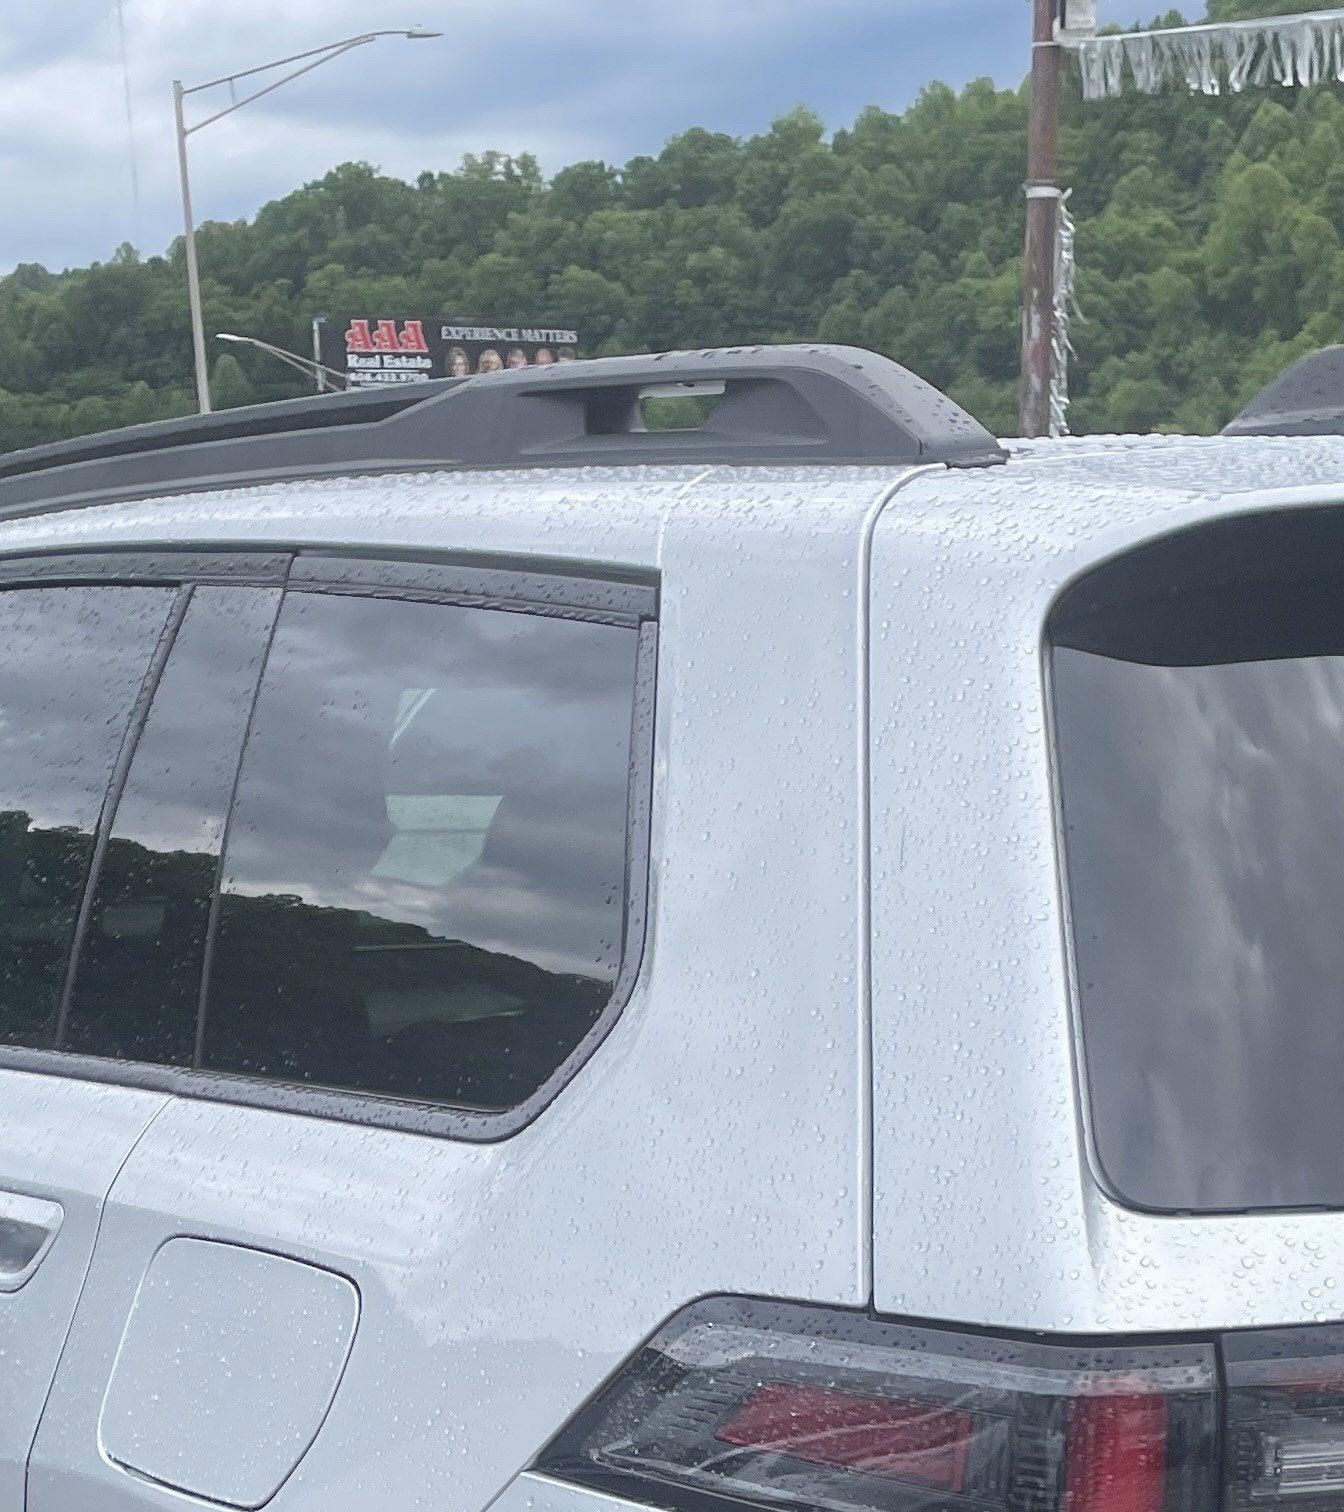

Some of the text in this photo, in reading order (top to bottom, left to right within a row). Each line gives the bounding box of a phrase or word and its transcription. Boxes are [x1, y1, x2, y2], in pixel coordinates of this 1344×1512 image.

[345, 319, 429, 353] AAA
[440, 325, 578, 344] EXPERIENCE MATTERS
[347, 353, 433, 369] Real Estate
